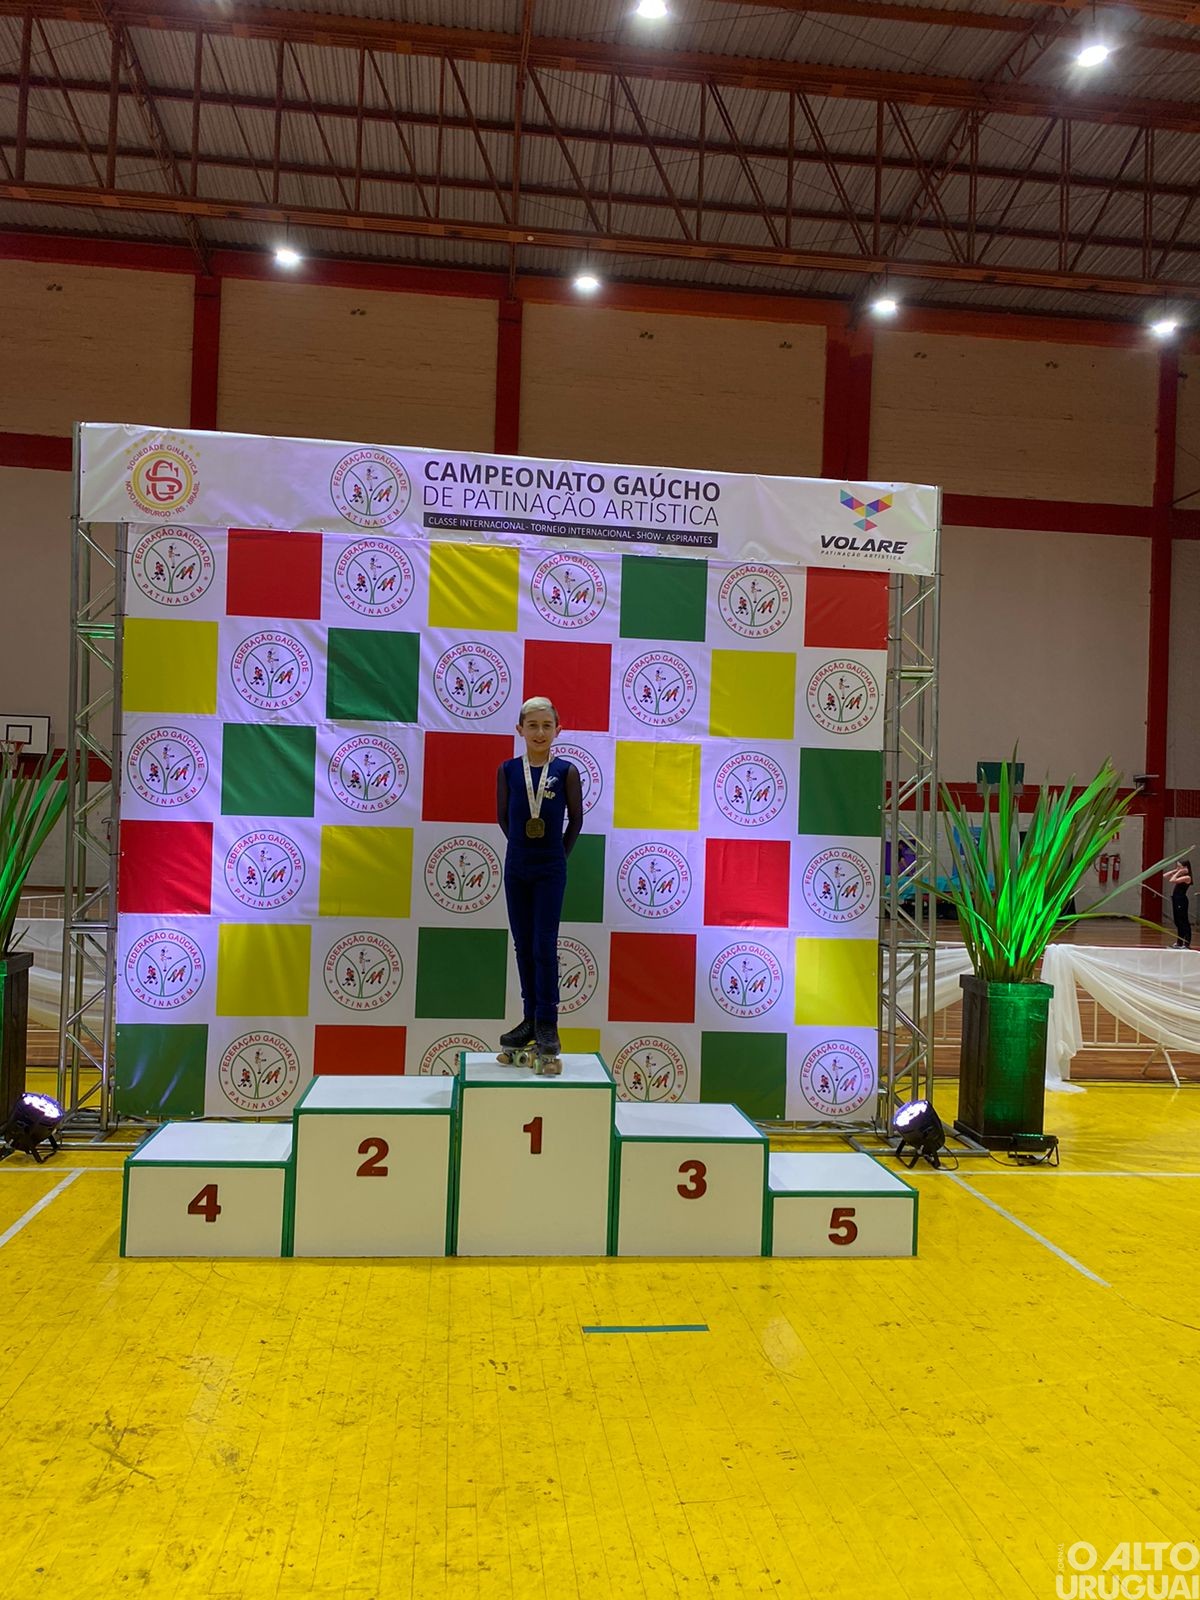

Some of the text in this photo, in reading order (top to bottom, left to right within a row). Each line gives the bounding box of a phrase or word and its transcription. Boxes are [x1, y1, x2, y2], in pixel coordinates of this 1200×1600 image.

[127, 444, 198, 476] SOCIEDADE GINÁSTICA
[333, 451, 372, 487] FEDERAÇÃO
[424, 460, 720, 502] CAMPEONATO GAÚCHO
[125, 480, 136, 500] NOVO
[134, 499, 171, 517] HAMBURGO
[188, 481, 200, 505] BRASIL
[340, 505, 400, 525] PATINAGEM
[424, 486, 719, 526] DE PATINAÇÃO ARTÍSTICA
[134, 528, 175, 564] FEDERAÇÃO
[428, 516, 458, 527] CLASSE
[531, 523, 566, 534] TORNEIO
[666, 534, 712, 544] ASPIRANTES
[820, 534, 908, 554] VOLARE
[337, 541, 376, 576] FEDERAÇÃO
[533, 554, 571, 589] FEDERAÇÃO
[143, 585, 204, 604] PATINAGEM
[721, 566, 758, 599] FEDERAÇÃO
[344, 594, 404, 615] PATINAGEM
[540, 607, 597, 626] PATINAGEM
[727, 617, 782, 636] PATINAGEM
[234, 634, 273, 669] FEDERAÇÃO
[436, 646, 474, 680] FEDERAÇÃO
[624, 655, 660, 688] FEDERAÇÃO
[809, 663, 845, 696] FEDERAÇÃO
[241, 688, 302, 708] PATINAGEM
[444, 699, 500, 717] PATINAGEM
[630, 705, 686, 724] PATINAGEM
[817, 714, 870, 732] PATINAGEM
[131, 730, 168, 765] FEDERAÇÃO
[331, 738, 370, 772] FEDERAÇÃO
[716, 755, 751, 789] FEDERAÇÃO
[138, 786, 198, 805] PATINAGEM
[337, 791, 397, 810] PATINAGEM
[722, 805, 777, 824] PATINAGEM
[227, 834, 266, 870] FEDERAÇÃO
[427, 839, 465, 875] FEDERAÇÃO
[620, 846, 656, 880] FEDERAÇÃO
[804, 851, 839, 886] FEDERAÇÃO
[234, 887, 293, 907] PATINAGEM
[434, 892, 492, 910] PATINAGEM
[626, 898, 682, 916] PATINAGEM
[811, 901, 865, 920] PATINAGEM
[128, 932, 166, 969] FEDERAÇÃO
[326, 936, 365, 971] FEDERAÇÃO
[713, 945, 748, 978] FEDERAÇÃO
[134, 987, 194, 1007] PATINAGEM
[334, 990, 392, 1009] PATINAGEM
[719, 997, 773, 1015] PATINAGEM
[222, 1036, 261, 1072] FEDERAÇÃO
[421, 1037, 484, 1072] FEDERAÇÃO GAÚC
[614, 1039, 651, 1074] FEDERAÇÃO
[804, 1044, 840, 1078] FEDERAÇÃO
[228, 1090, 289, 1109] PATINAGEM
[810, 1096, 864, 1113] PATINAGEM
[522, 1116, 544, 1155] 1
[356, 1136, 389, 1176] 2
[676, 1159, 708, 1200] 3
[188, 1184, 222, 1223] 4
[828, 1206, 858, 1246] 5
